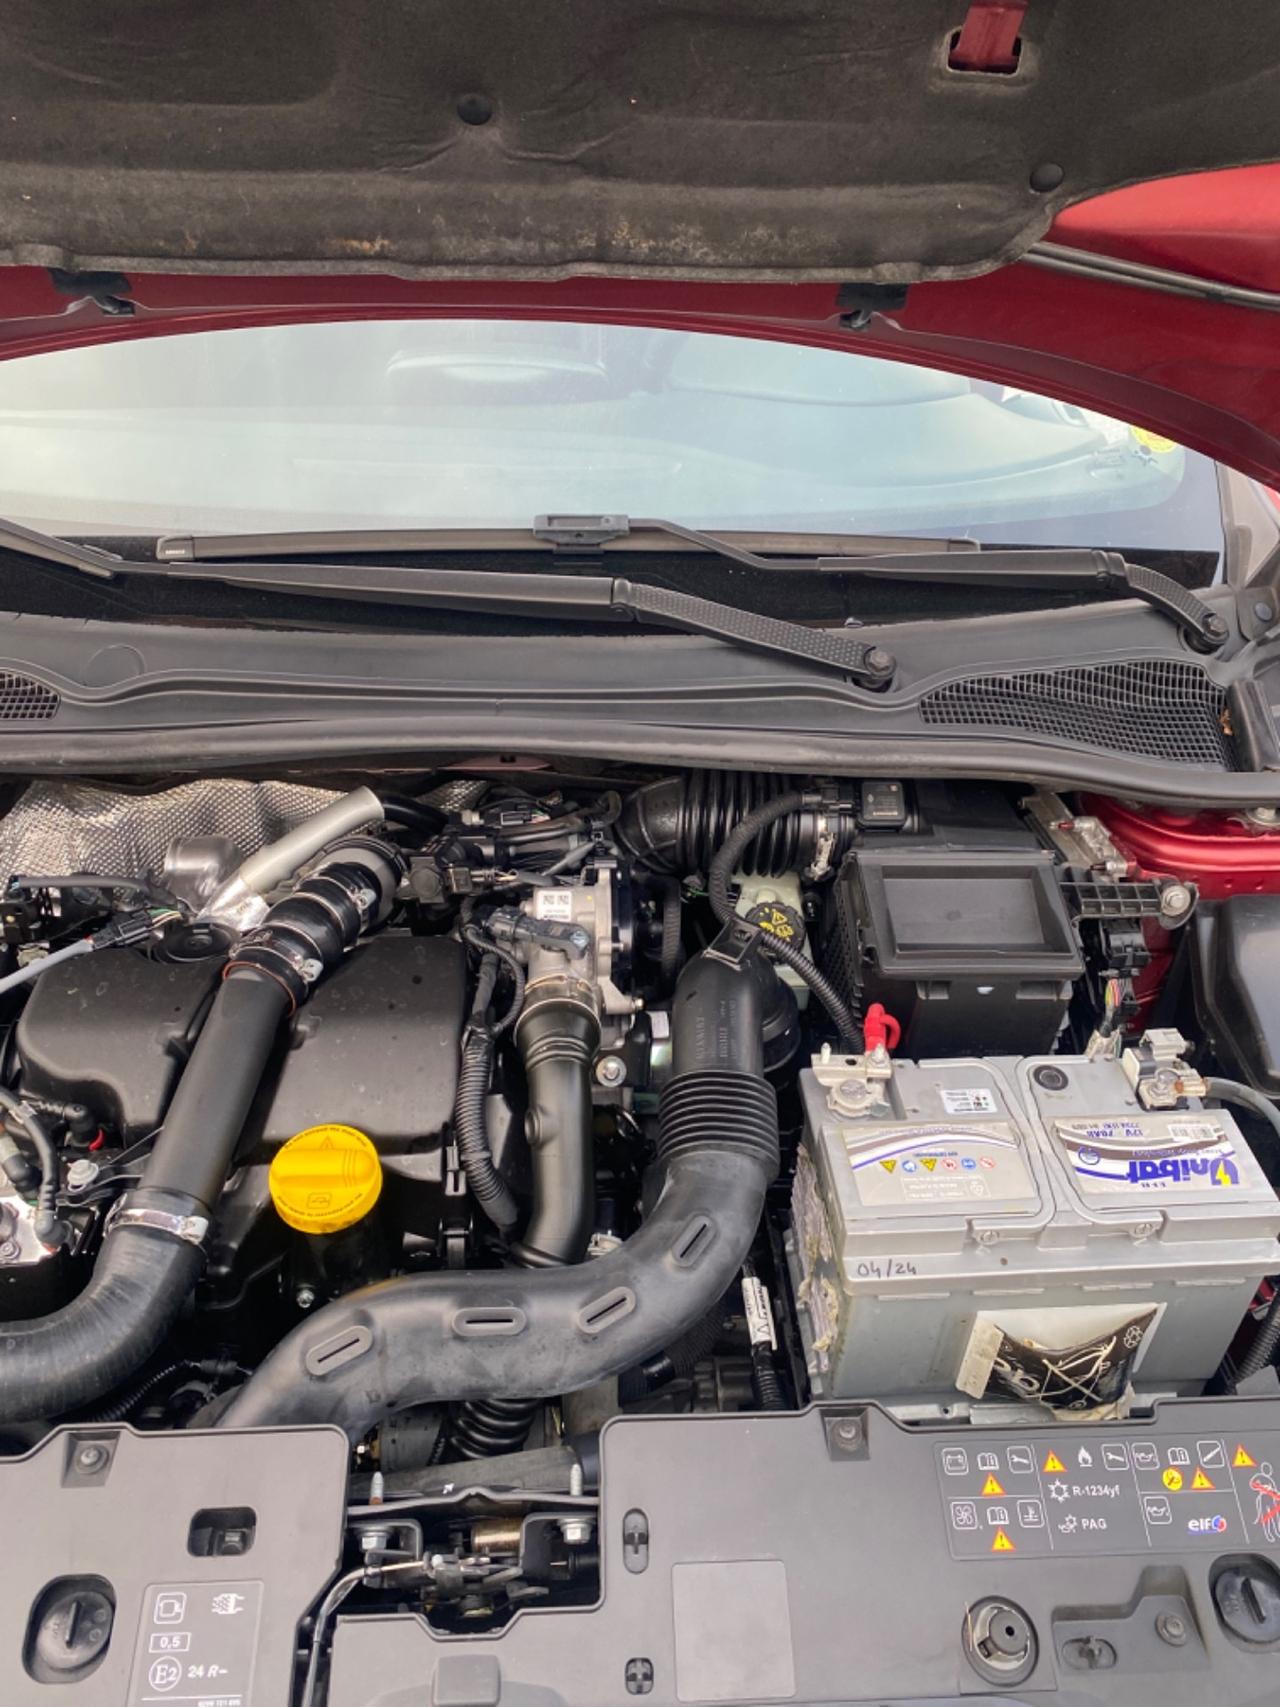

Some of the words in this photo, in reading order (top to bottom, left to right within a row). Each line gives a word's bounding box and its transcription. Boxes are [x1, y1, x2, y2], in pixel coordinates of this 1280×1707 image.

[1126, 1157, 1239, 1186] Unibat
[857, 1259, 916, 1278] 04/24
[1072, 1484, 1120, 1498] R-1234yf
[1081, 1518, 1107, 1530] PAG
[1188, 1518, 1216, 1532] elf
[155, 1664, 178, 1684] E2
[187, 1665, 205, 1679] 24
